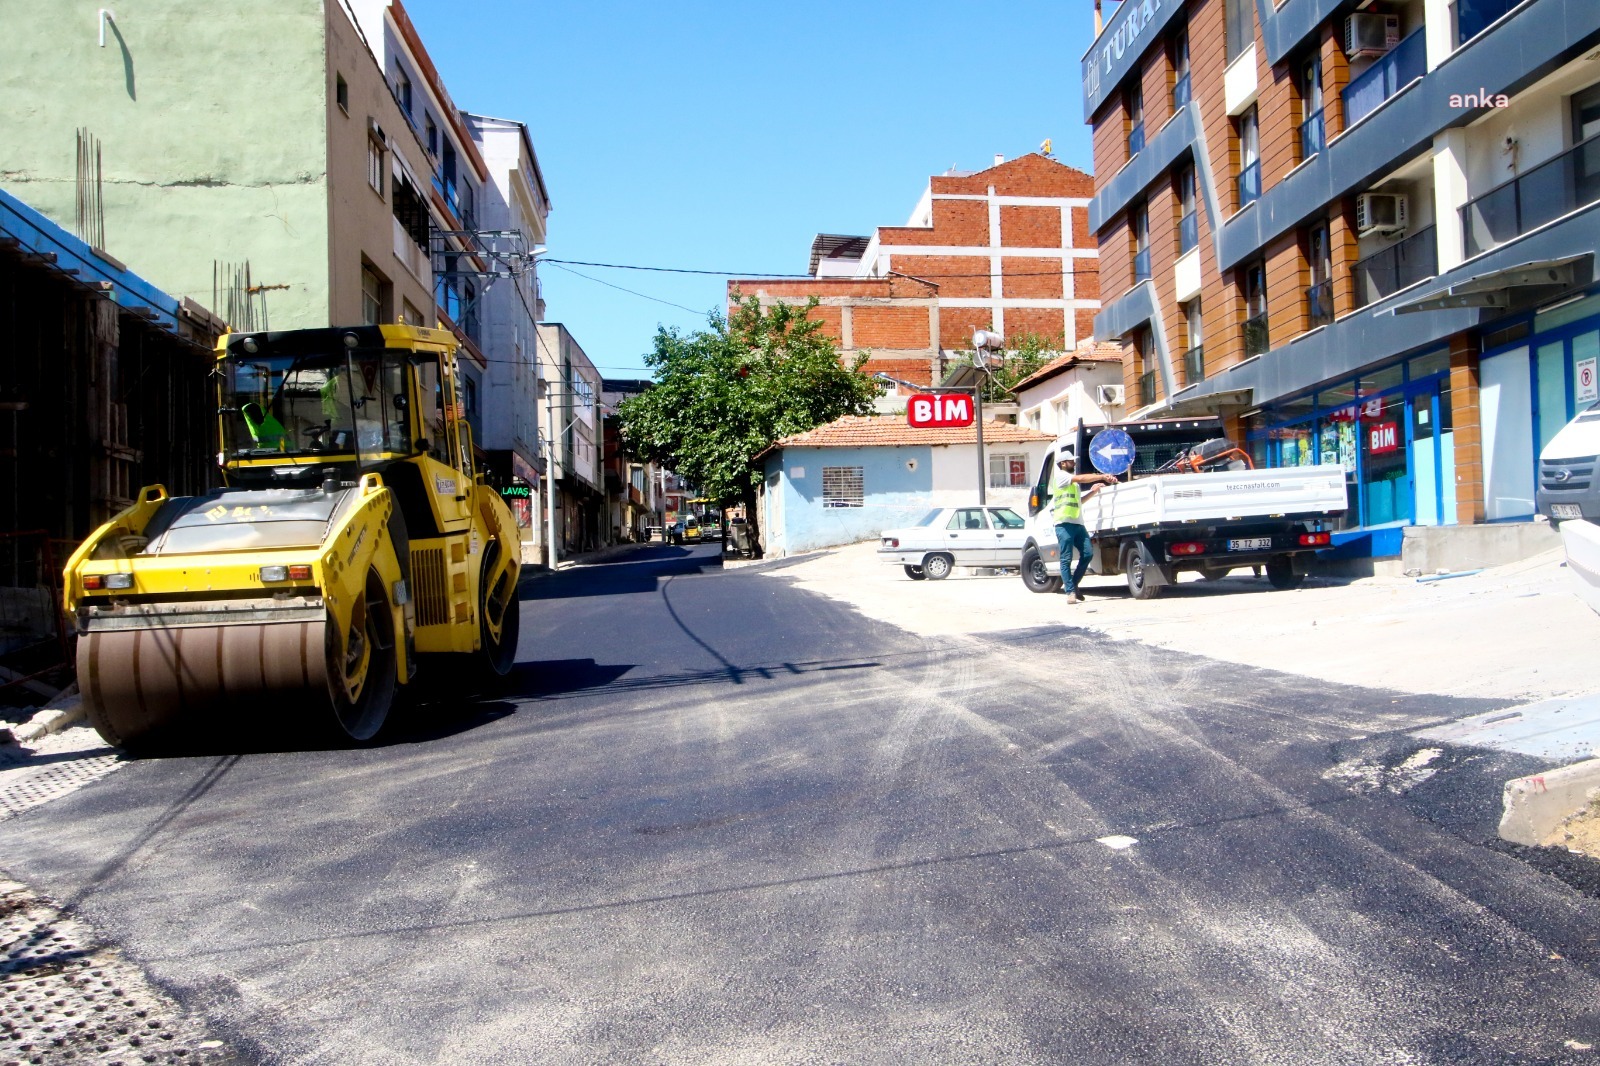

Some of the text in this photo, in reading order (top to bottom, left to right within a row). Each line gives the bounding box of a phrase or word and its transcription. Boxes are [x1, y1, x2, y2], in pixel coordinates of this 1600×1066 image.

[1103, 0, 1161, 75] TURA
[914, 394, 969, 422] BİM
[1371, 424, 1395, 450] BİM
[502, 486, 529, 498] LAVAŞ
[1231, 538, 1270, 549] 35 TZ 332
